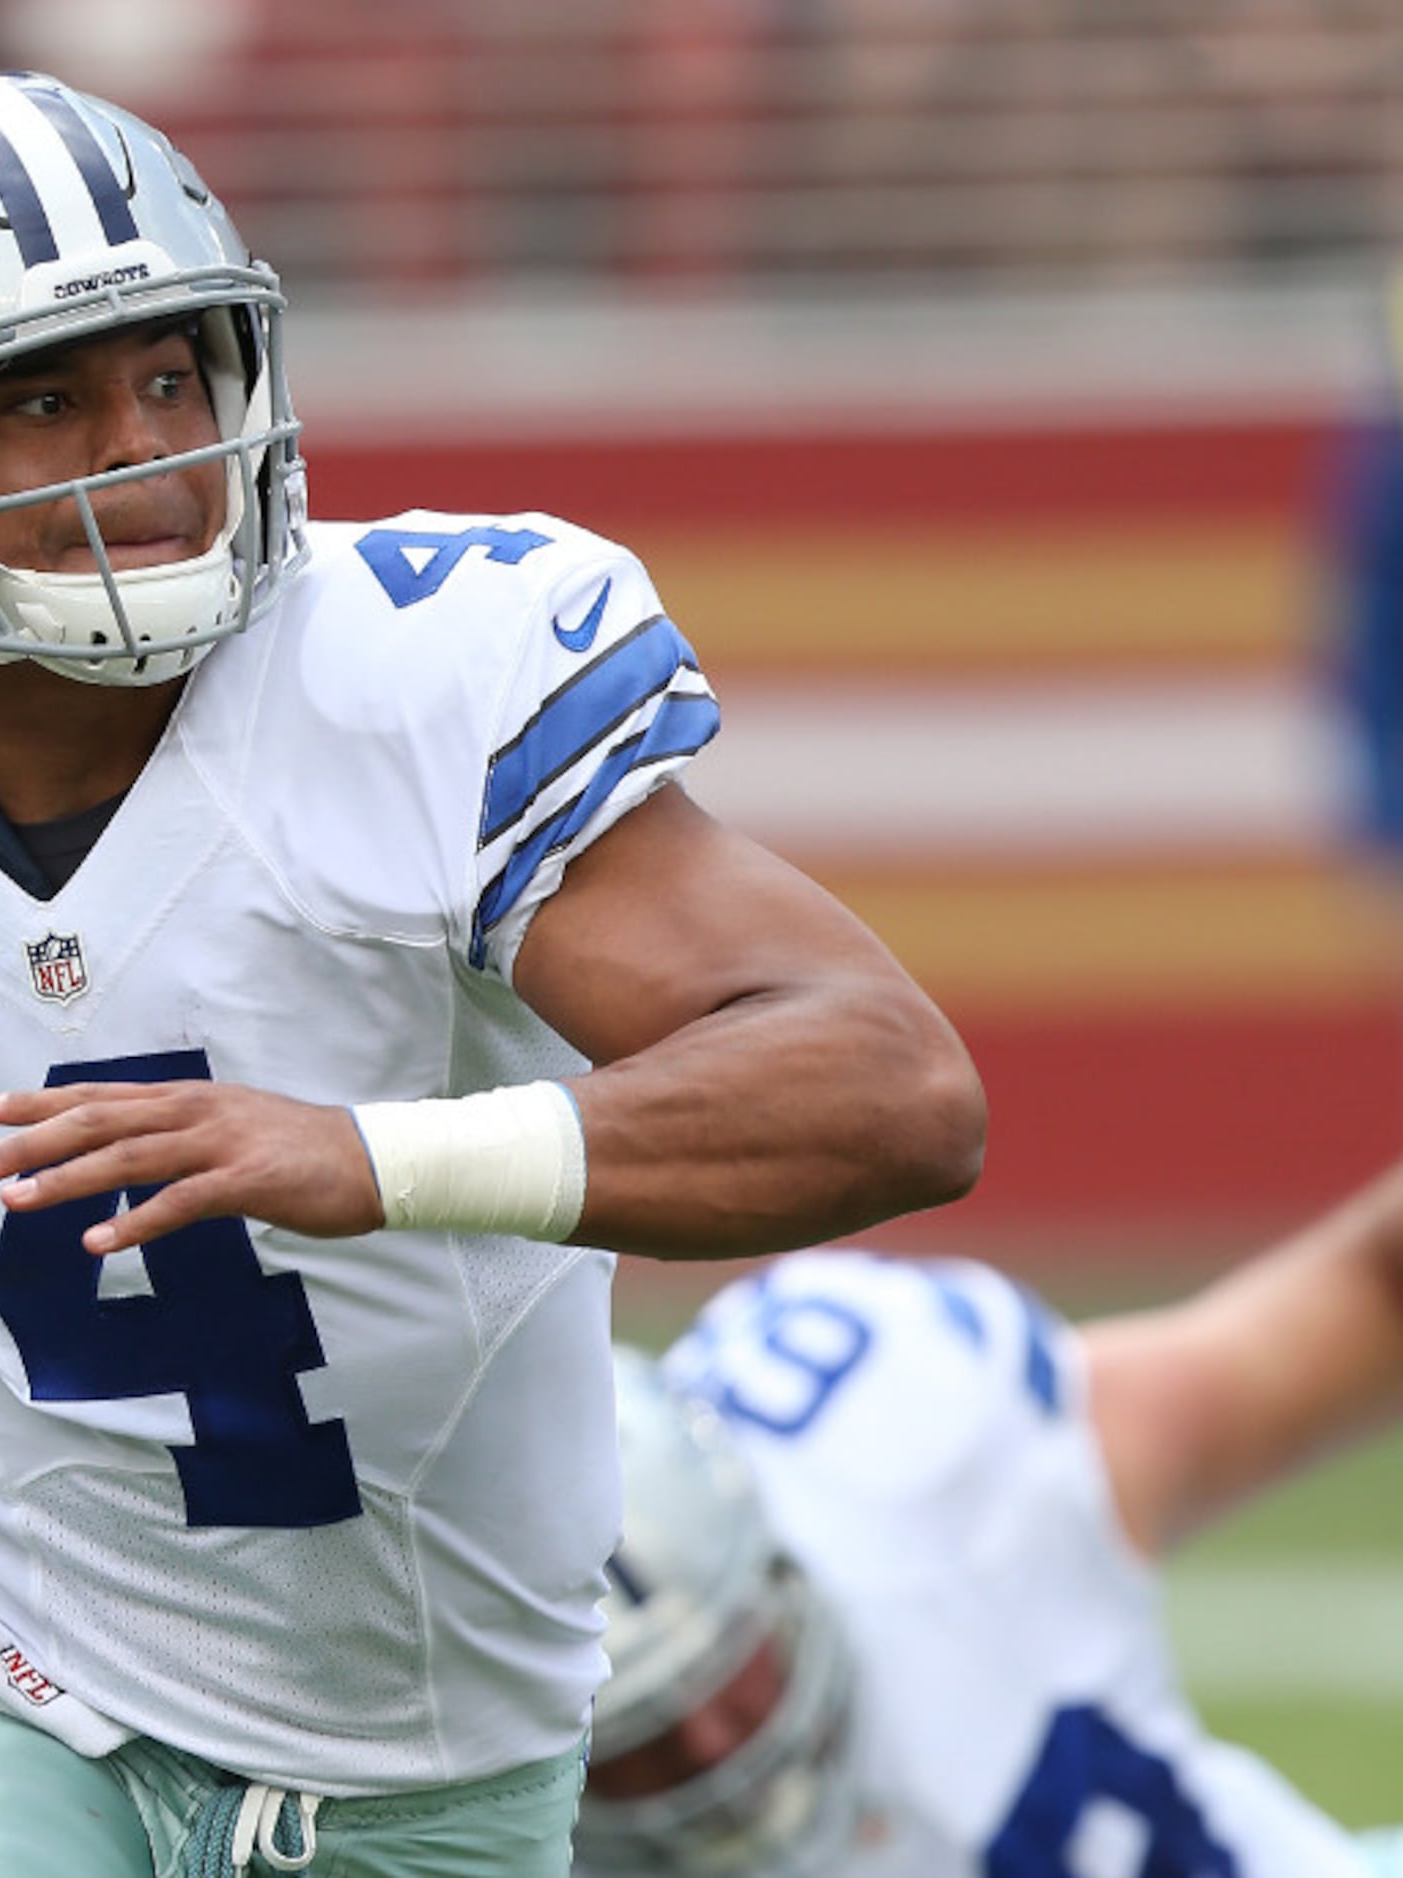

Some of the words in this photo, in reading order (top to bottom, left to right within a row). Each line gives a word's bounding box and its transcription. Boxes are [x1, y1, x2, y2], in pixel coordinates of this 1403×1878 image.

[354, 525, 555, 609] 4
[38, 959, 84, 992] NFL
[2, 1647, 51, 1700] NFL
